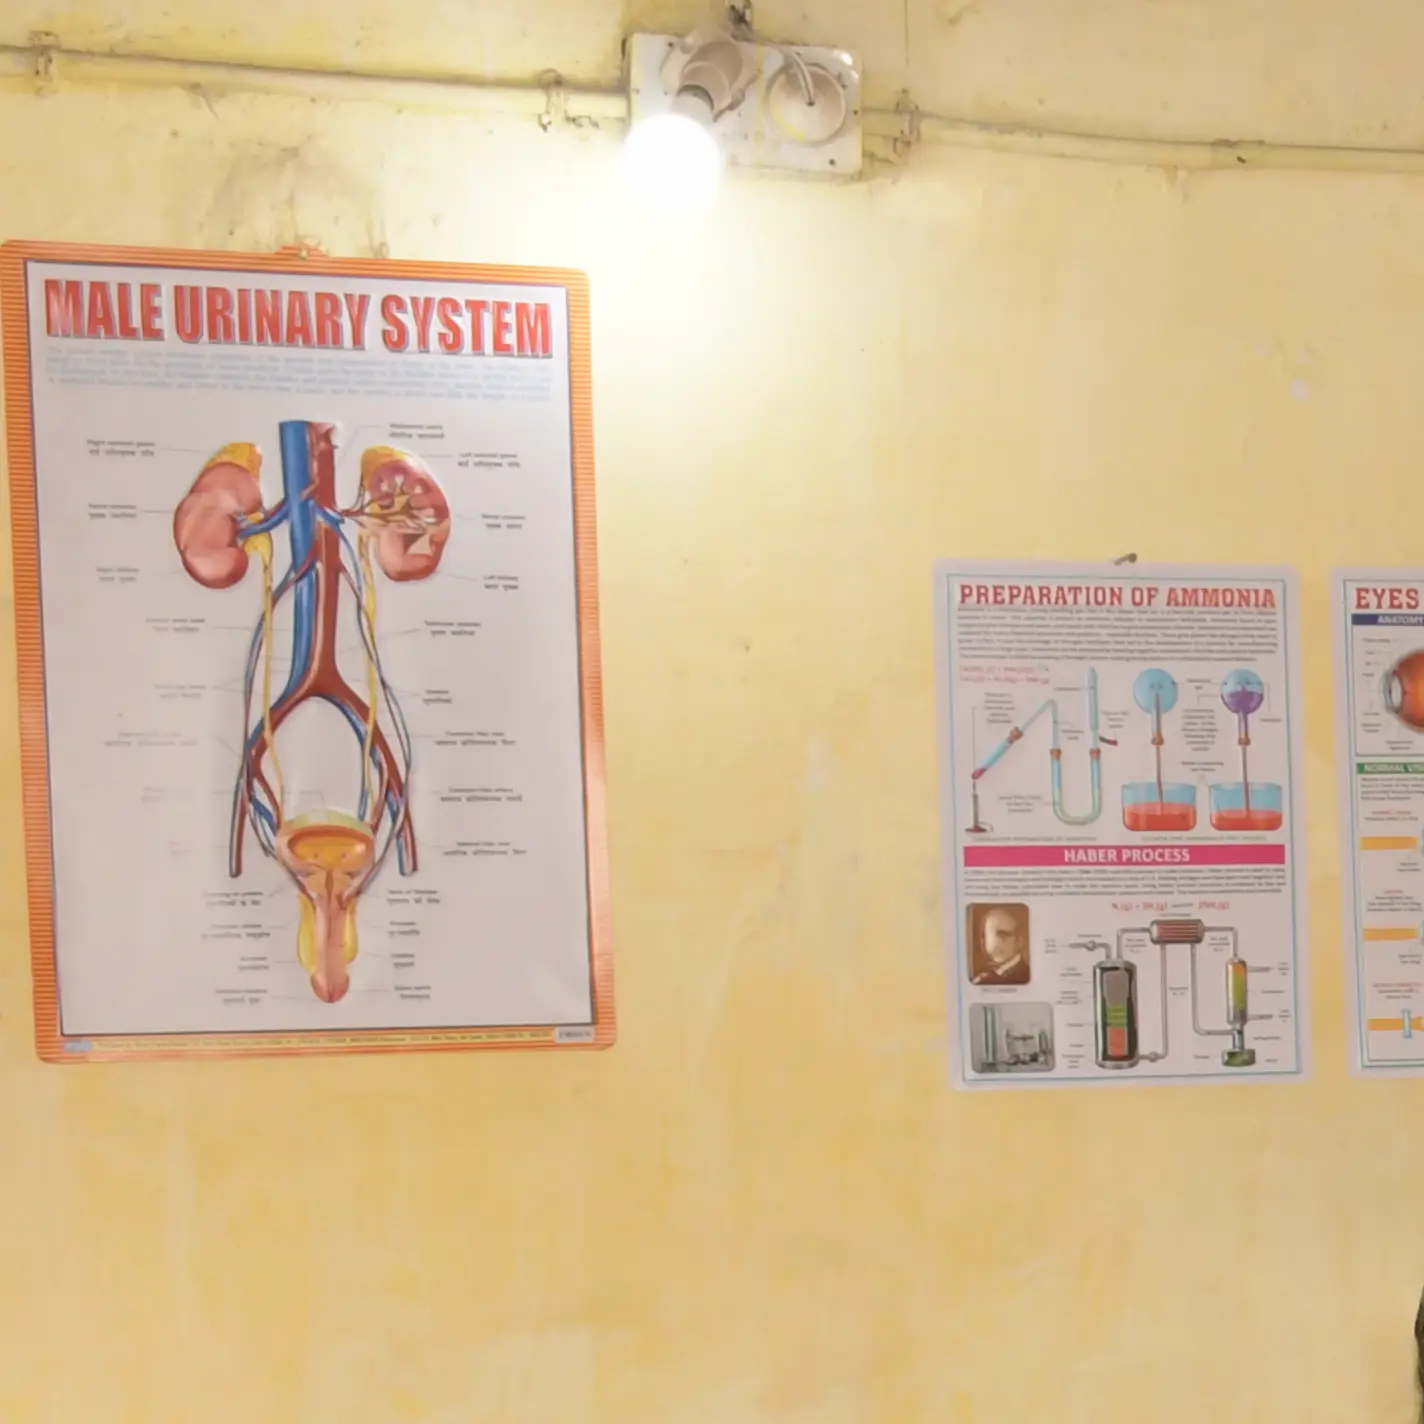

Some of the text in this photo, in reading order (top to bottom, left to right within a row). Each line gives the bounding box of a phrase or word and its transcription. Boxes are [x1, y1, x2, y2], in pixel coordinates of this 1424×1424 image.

[44, 278, 553, 359] MALE URINARY SYSTEM
[960, 583, 1276, 608] PREPARATION OF AMMONIA
[1355, 587, 1419, 610] EYES
[1064, 848, 1190, 863] HABER PROCESS
